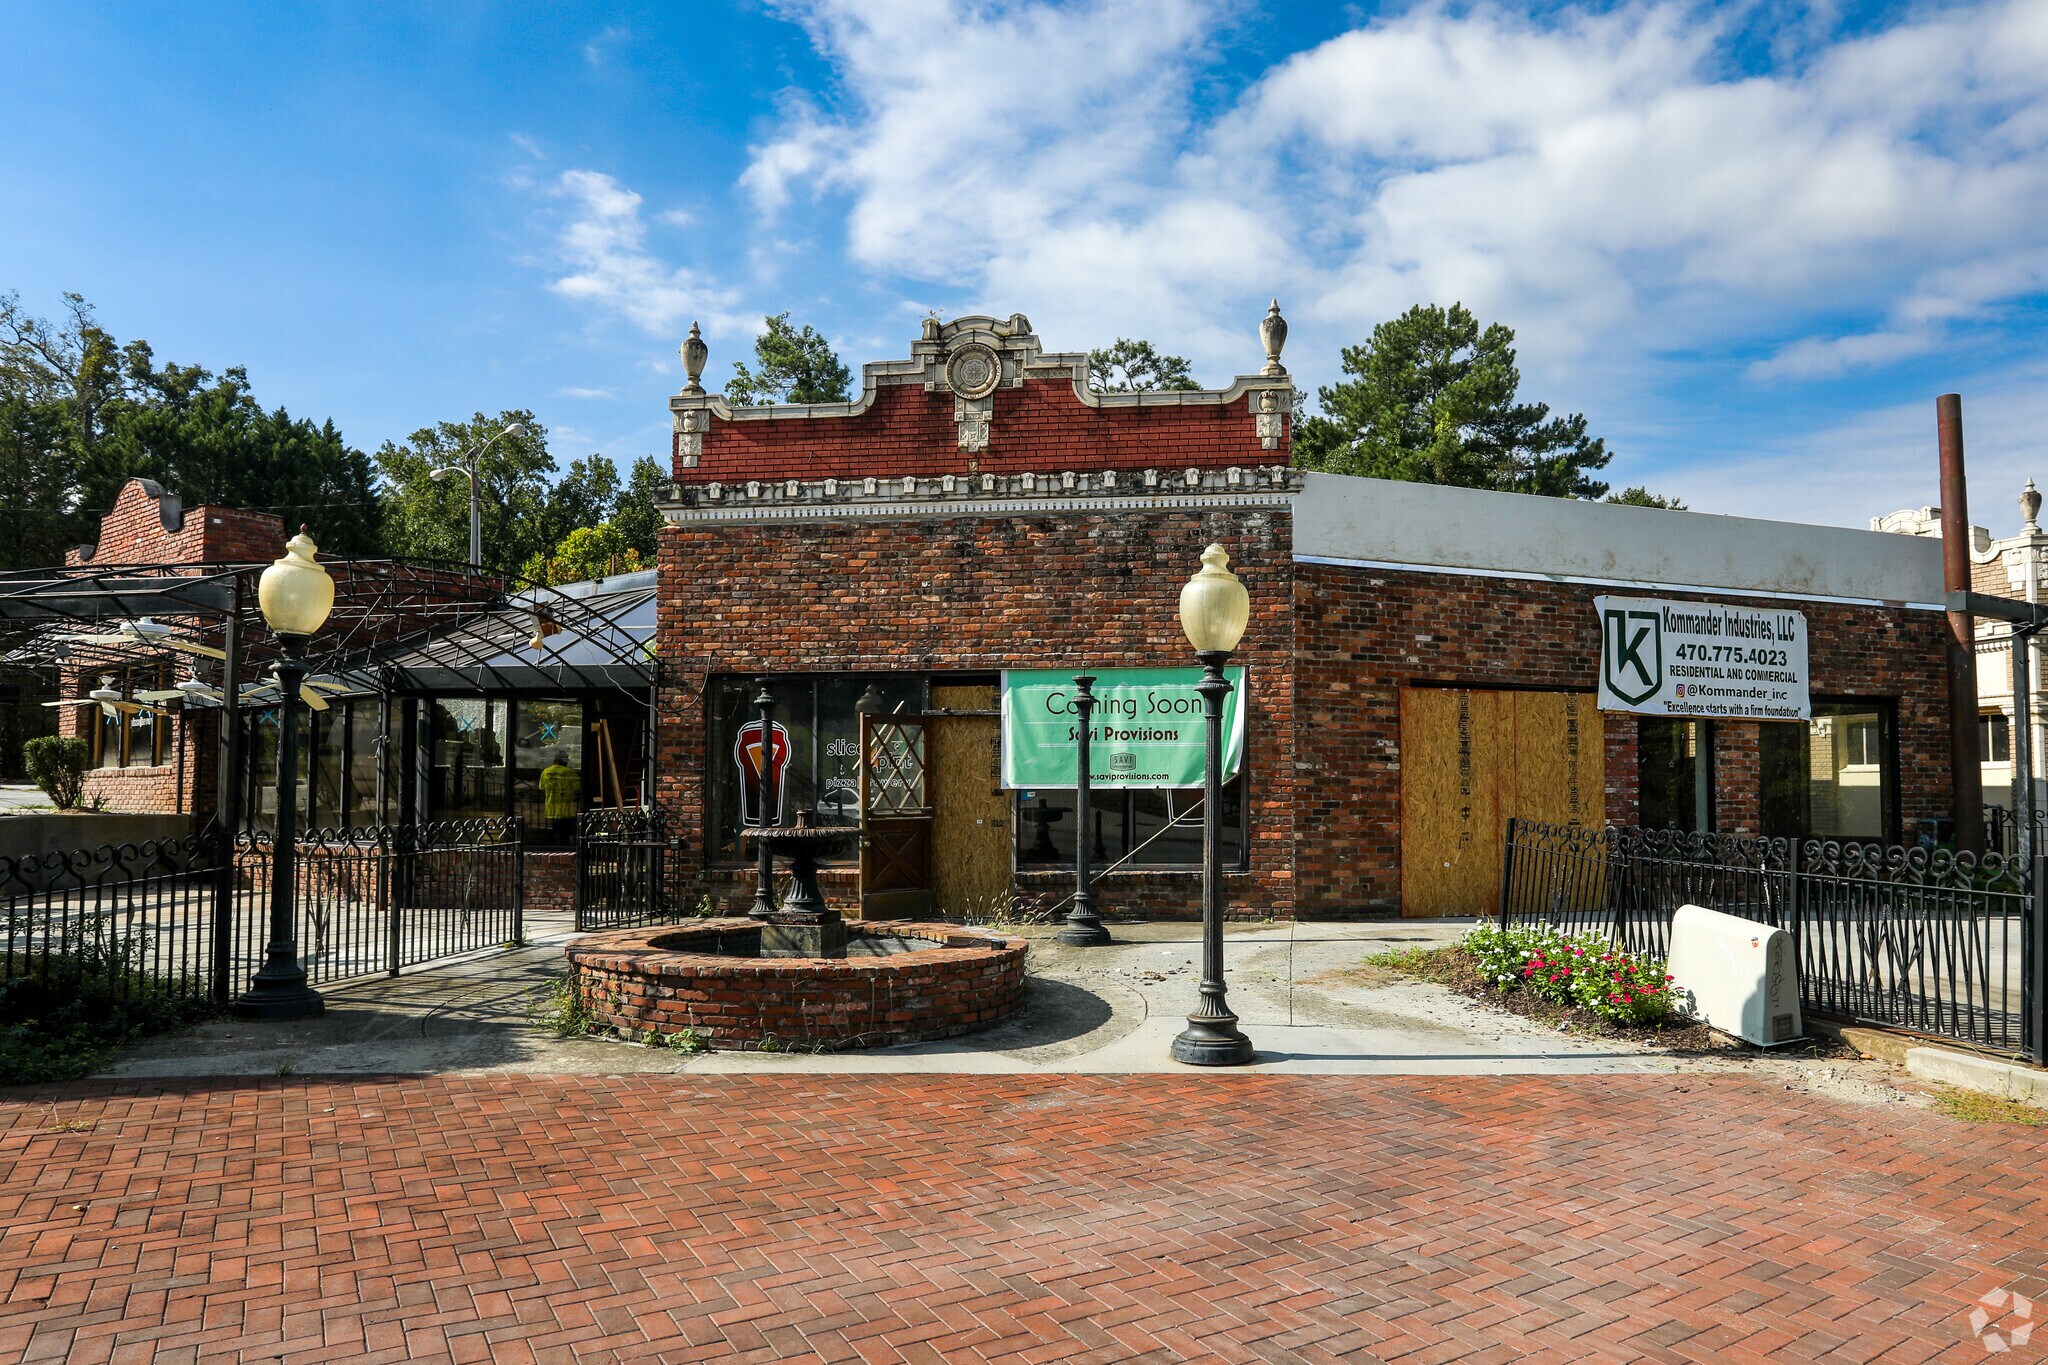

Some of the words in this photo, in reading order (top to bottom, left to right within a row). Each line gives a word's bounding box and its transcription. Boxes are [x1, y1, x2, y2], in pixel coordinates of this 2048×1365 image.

[1663, 606, 1722, 636] Kommander
[1725, 610, 1775, 645] Industries,
[1777, 615, 1795, 642] LLC
[1676, 643, 1787, 666] 470.775.4023
[1670, 665, 1724, 679] RESIDENTIAL
[1726, 668, 1743, 680] AND
[1745, 669, 1797, 683] COMMERCIAL
[1687, 684, 1787, 701] @Kommander_inc
[1147, 691, 1202, 714] Soon
[1664, 700, 1705, 713] "Excellence
[1706, 703, 1727, 714] starts
[1728, 704, 1743, 715] with
[1744, 707, 1750, 715] a
[1750, 705, 1763, 716] firm
[1764, 706, 1802, 717] foundation"
[1104, 726, 1179, 741] Provisions
[826, 776, 857, 789] pizza
